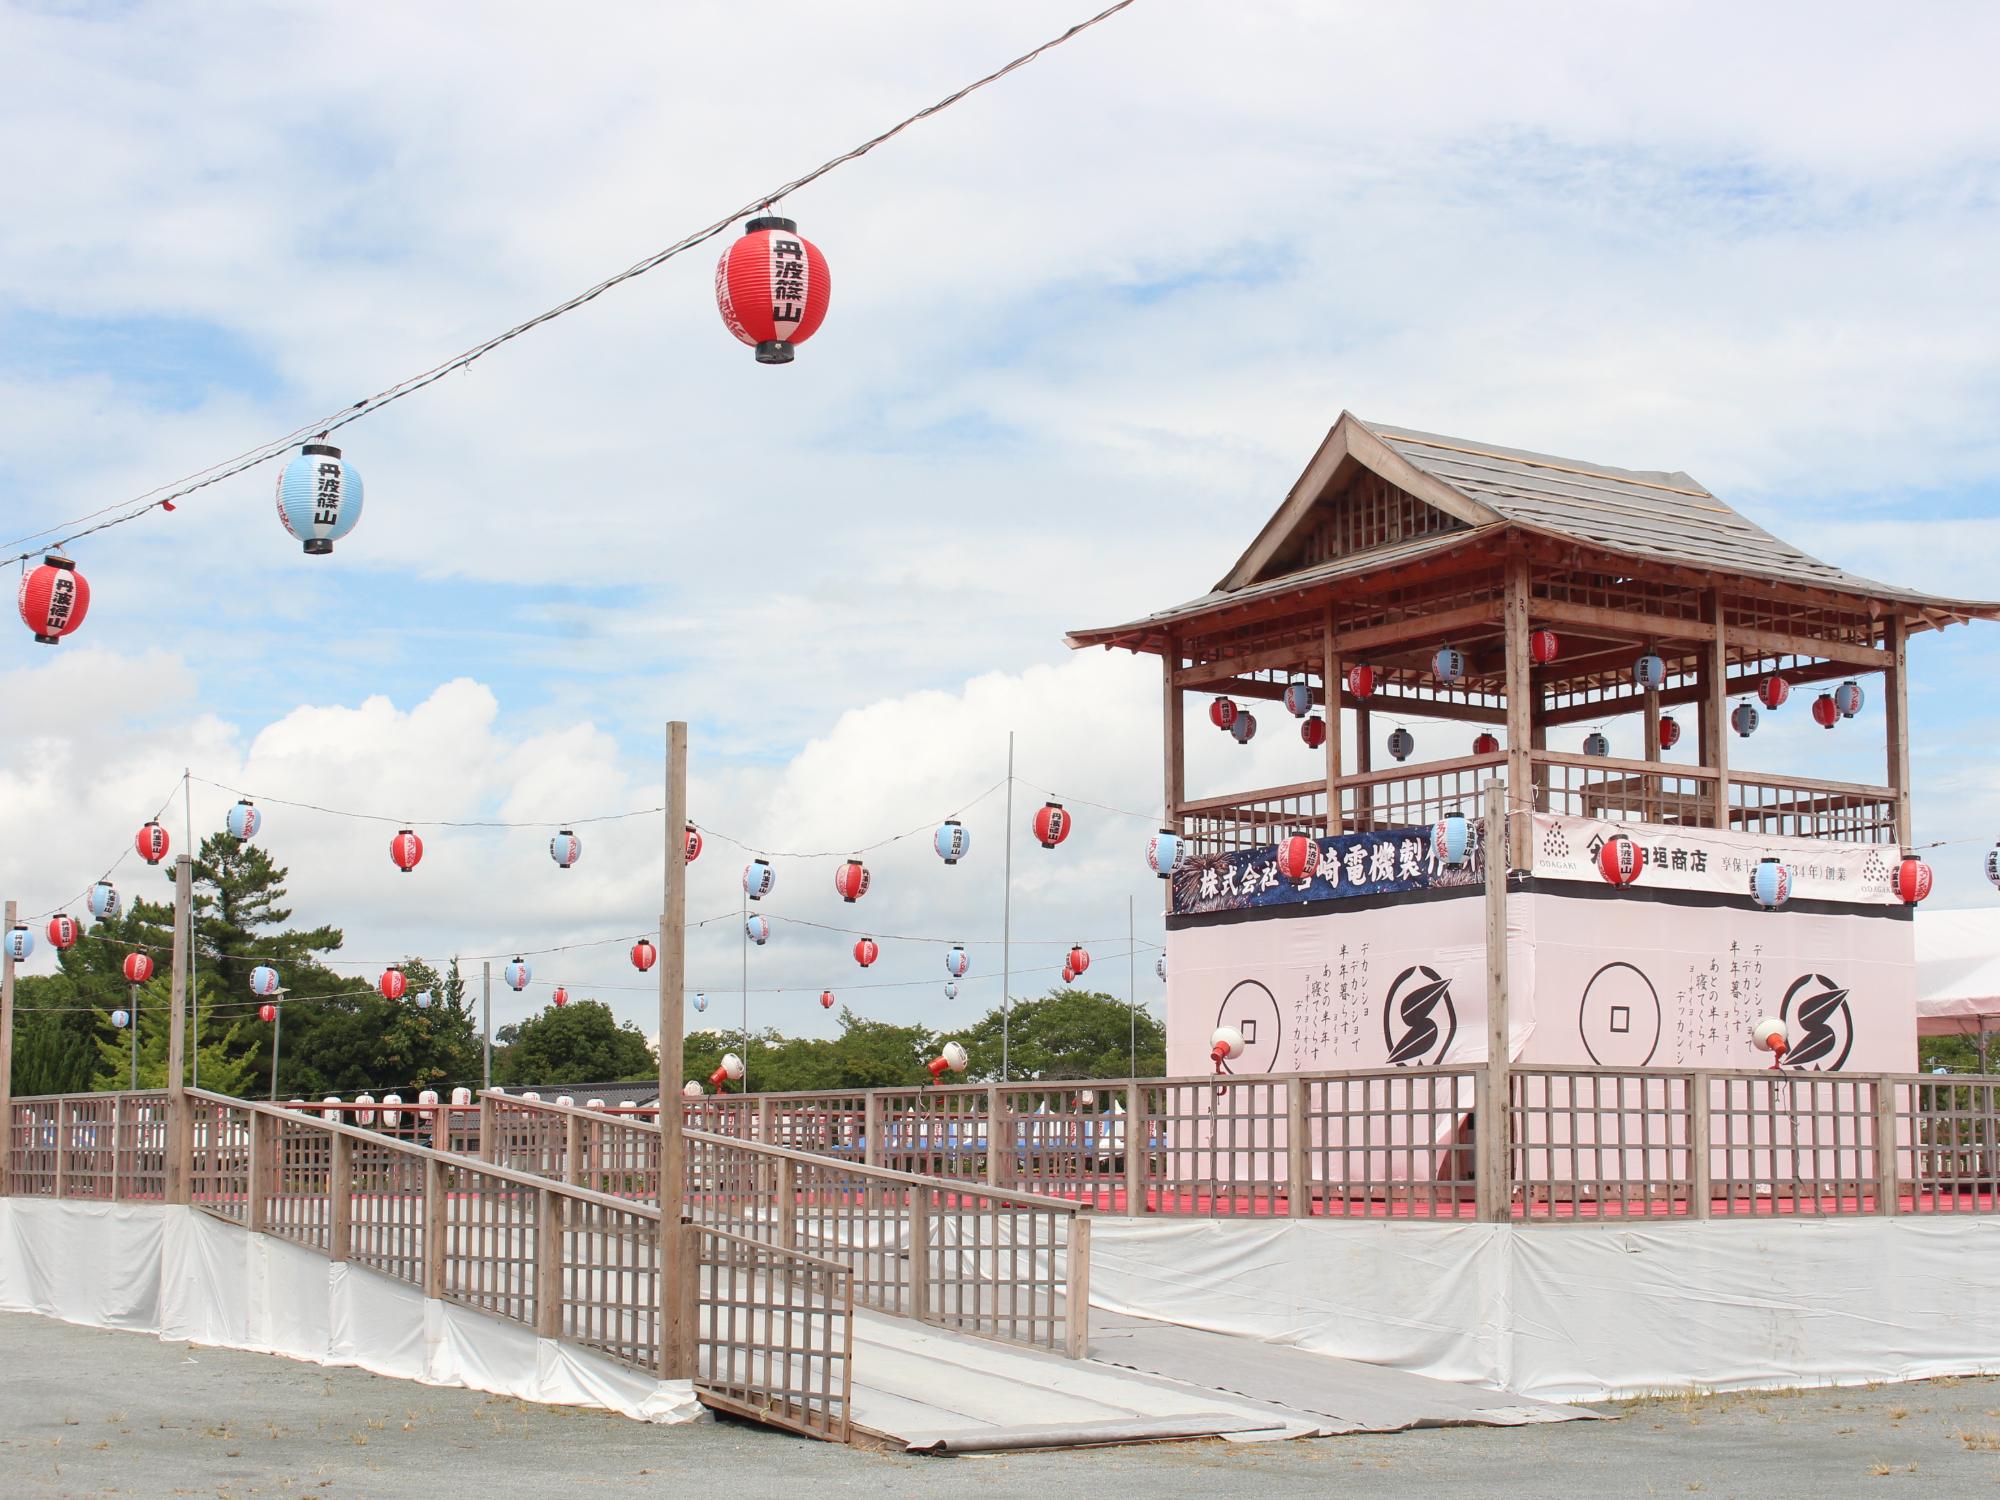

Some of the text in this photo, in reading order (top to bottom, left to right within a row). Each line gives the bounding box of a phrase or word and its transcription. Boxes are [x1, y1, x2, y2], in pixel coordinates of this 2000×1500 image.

[773, 240, 802, 323] 丹波篠山
[314, 463, 341, 525] 丹波篠山
[47, 579, 74, 629] 丹波篠山
[951, 829, 962, 855] 丹波篠山
[1048, 813, 1061, 841] 丹波篠山
[1172, 841, 1184, 869] 丹波篠山
[1200, 837, 1477, 899] 株式会社崎電機製
[1303, 842, 1317, 873] 丹波篠山
[1540, 859, 1576, 870] ODAGAKI
[1621, 842, 1631, 874] 丹波篠山
[1861, 885, 1893, 894] ODAGAK
[1321, 963, 1331, 1047] あとの半年
[1339, 944, 1350, 1034] 半年暮らす
[1708, 958, 1719, 1043] あとの半年
[1730, 940, 1742, 1033] 半年暮らす
